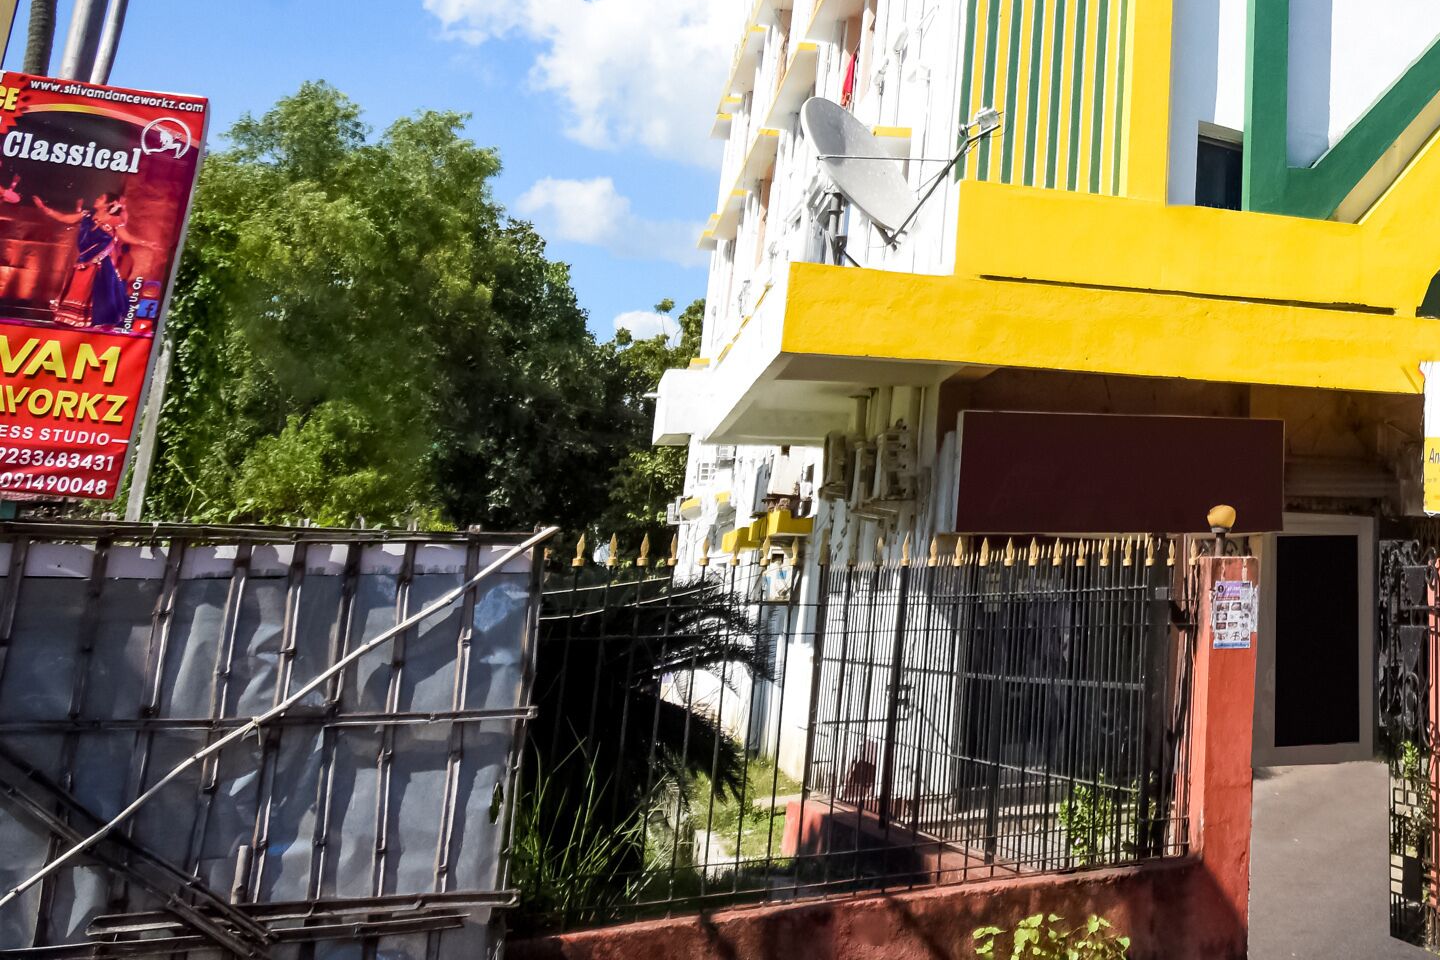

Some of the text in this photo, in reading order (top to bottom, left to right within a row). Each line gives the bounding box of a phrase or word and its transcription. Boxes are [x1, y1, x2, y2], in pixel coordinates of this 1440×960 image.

[30, 80, 204, 113] www.shivamdanceworkz.com
[3, 131, 142, 174] Classical
[121, 277, 143, 334] Follow Us On
[39, 428, 110, 446] STUDIO
